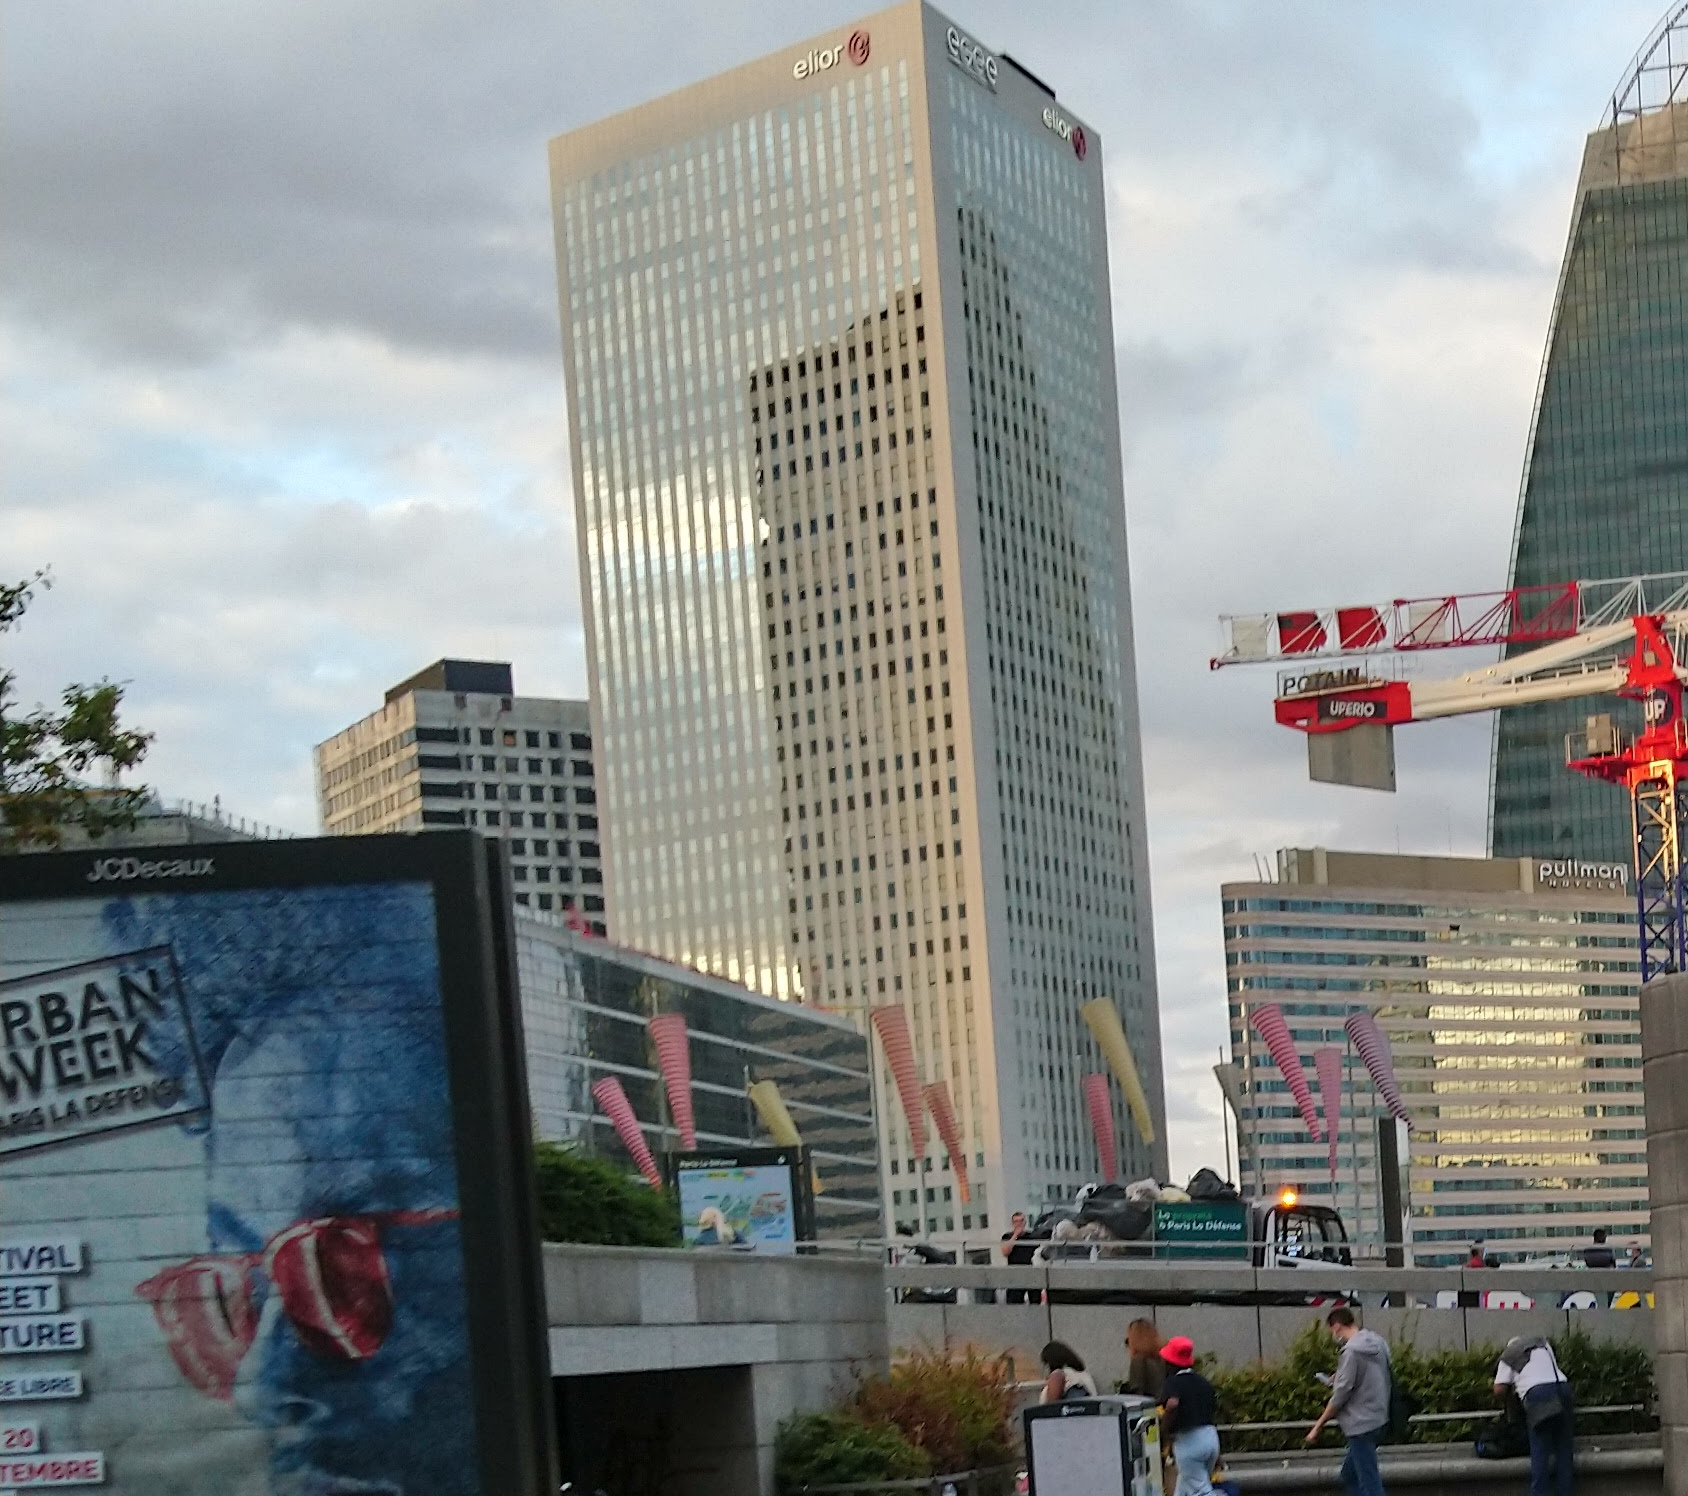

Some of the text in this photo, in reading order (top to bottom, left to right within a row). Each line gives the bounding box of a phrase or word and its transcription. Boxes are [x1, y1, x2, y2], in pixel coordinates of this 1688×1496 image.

[793, 45, 845, 80] elior
[1042, 107, 1072, 141] elior
[1283, 667, 1360, 696] POTAIN
[1645, 698, 1666, 721] UP
[87, 857, 216, 882] JCDecaux
[1540, 858, 1625, 886] pullman
[0, 1020, 164, 1102] WEEK
[3, 1428, 33, 1448] 20
